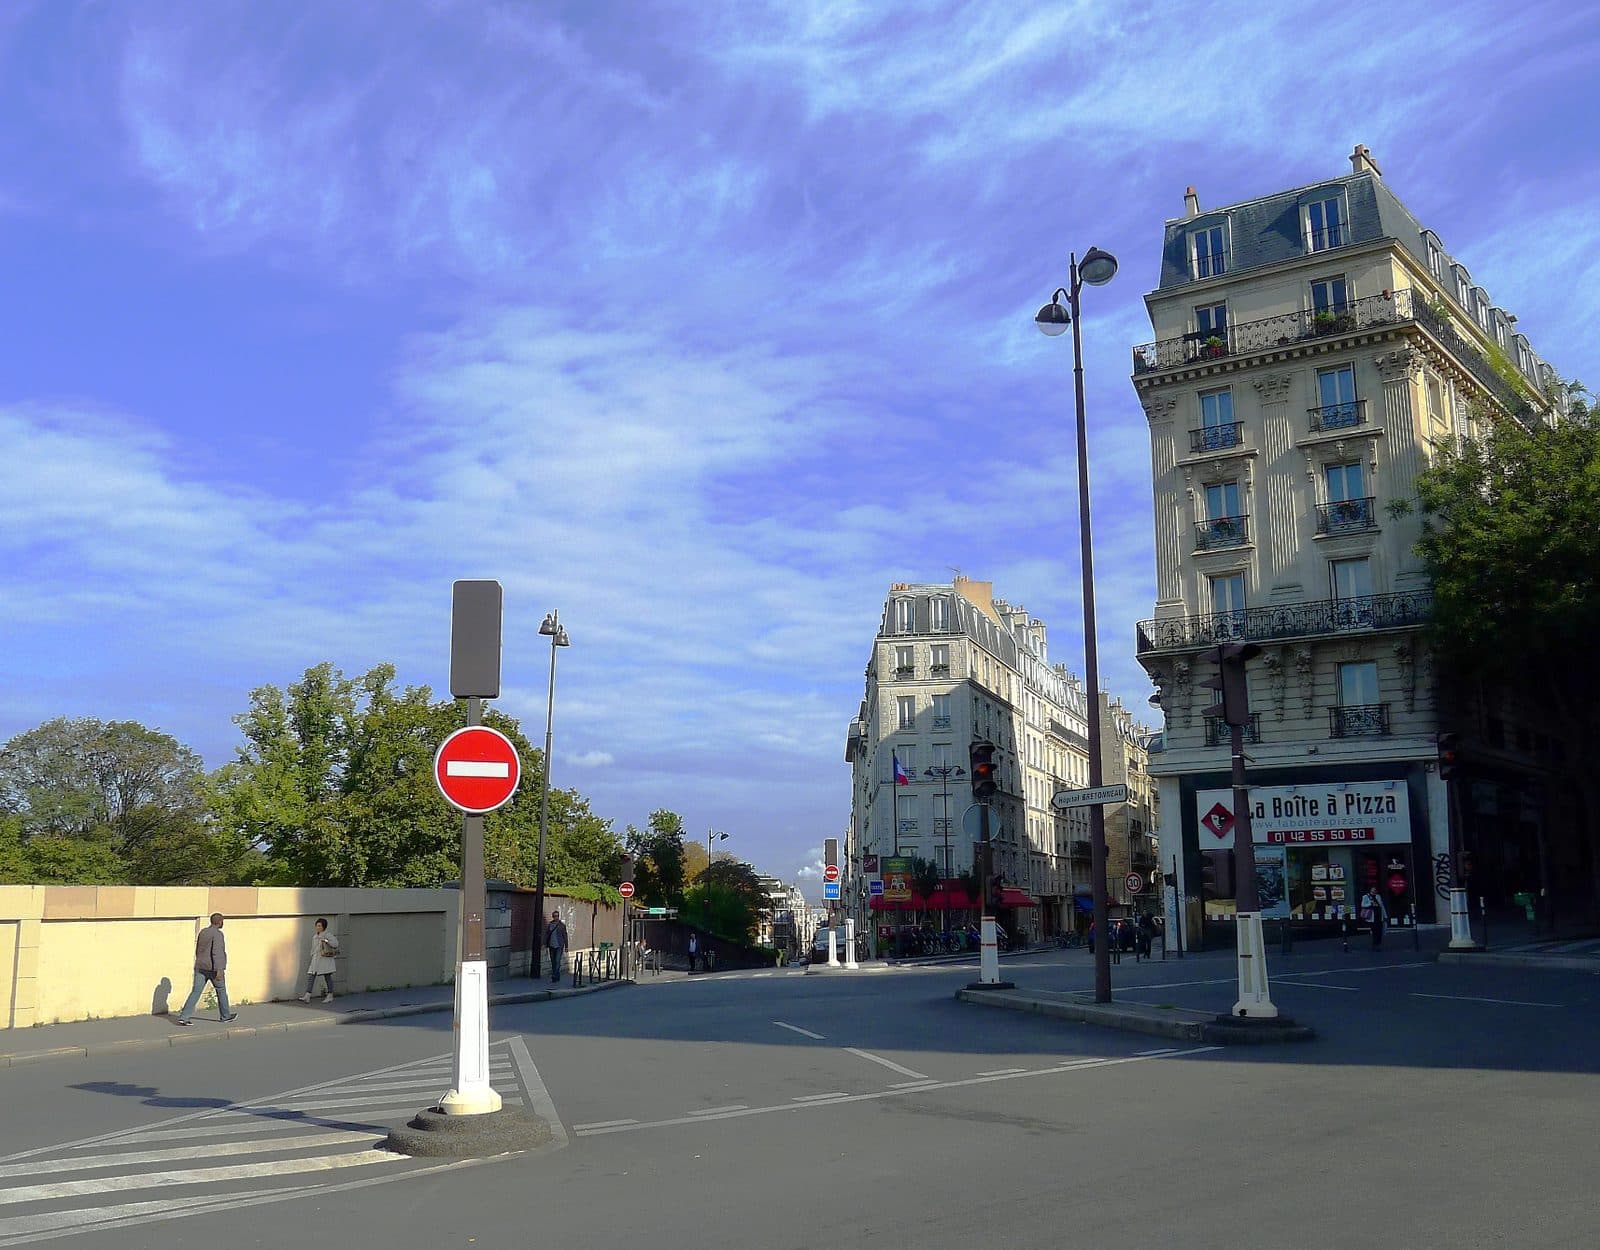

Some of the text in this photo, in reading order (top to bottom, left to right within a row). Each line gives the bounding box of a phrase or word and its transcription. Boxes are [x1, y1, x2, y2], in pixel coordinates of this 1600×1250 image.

[1082, 788, 1124, 801] BRETONNEAU
[1272, 795, 1319, 818] Boîte
[1327, 793, 1337, 816] à
[1345, 792, 1396, 816] Pizza
[1274, 829, 1366, 843] 01 42 55 50 50
[1128, 878, 1139, 888] 30
